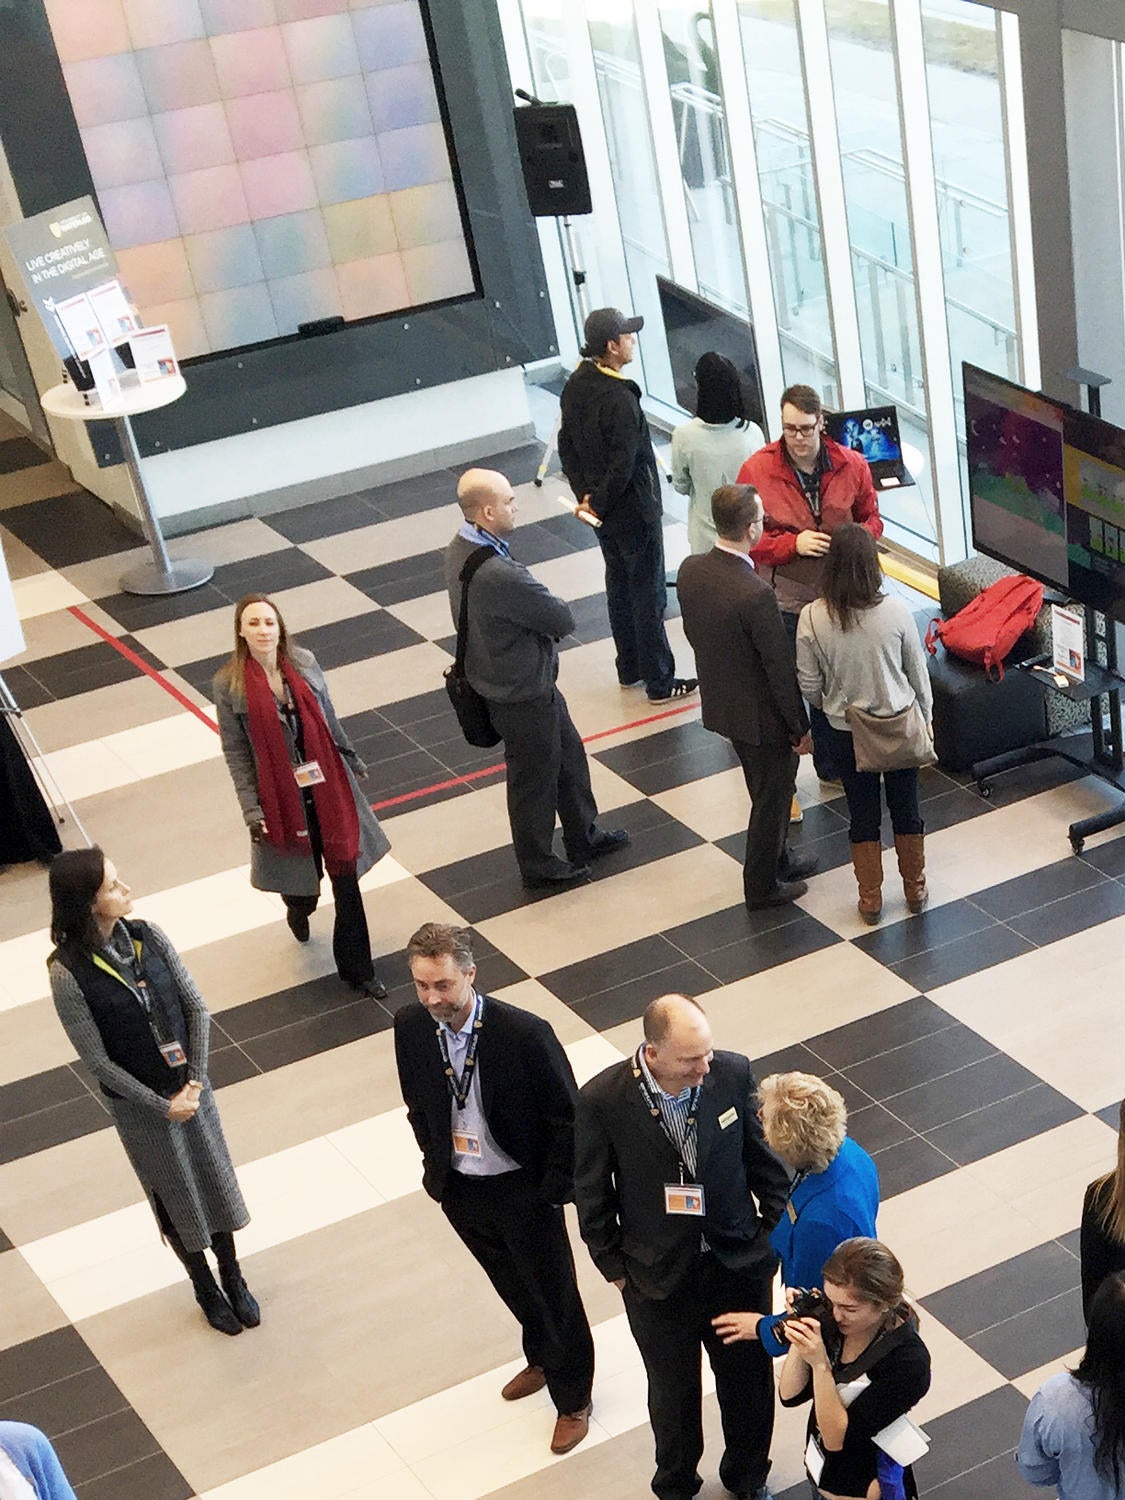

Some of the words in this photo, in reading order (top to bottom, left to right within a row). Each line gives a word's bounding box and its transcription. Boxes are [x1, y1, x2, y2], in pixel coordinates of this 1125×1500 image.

[25, 256, 45, 271] LIVE
[44, 238, 90, 264] CREATIVELY
[41, 265, 59, 279] THE
[57, 256, 89, 274] DIGITAL
